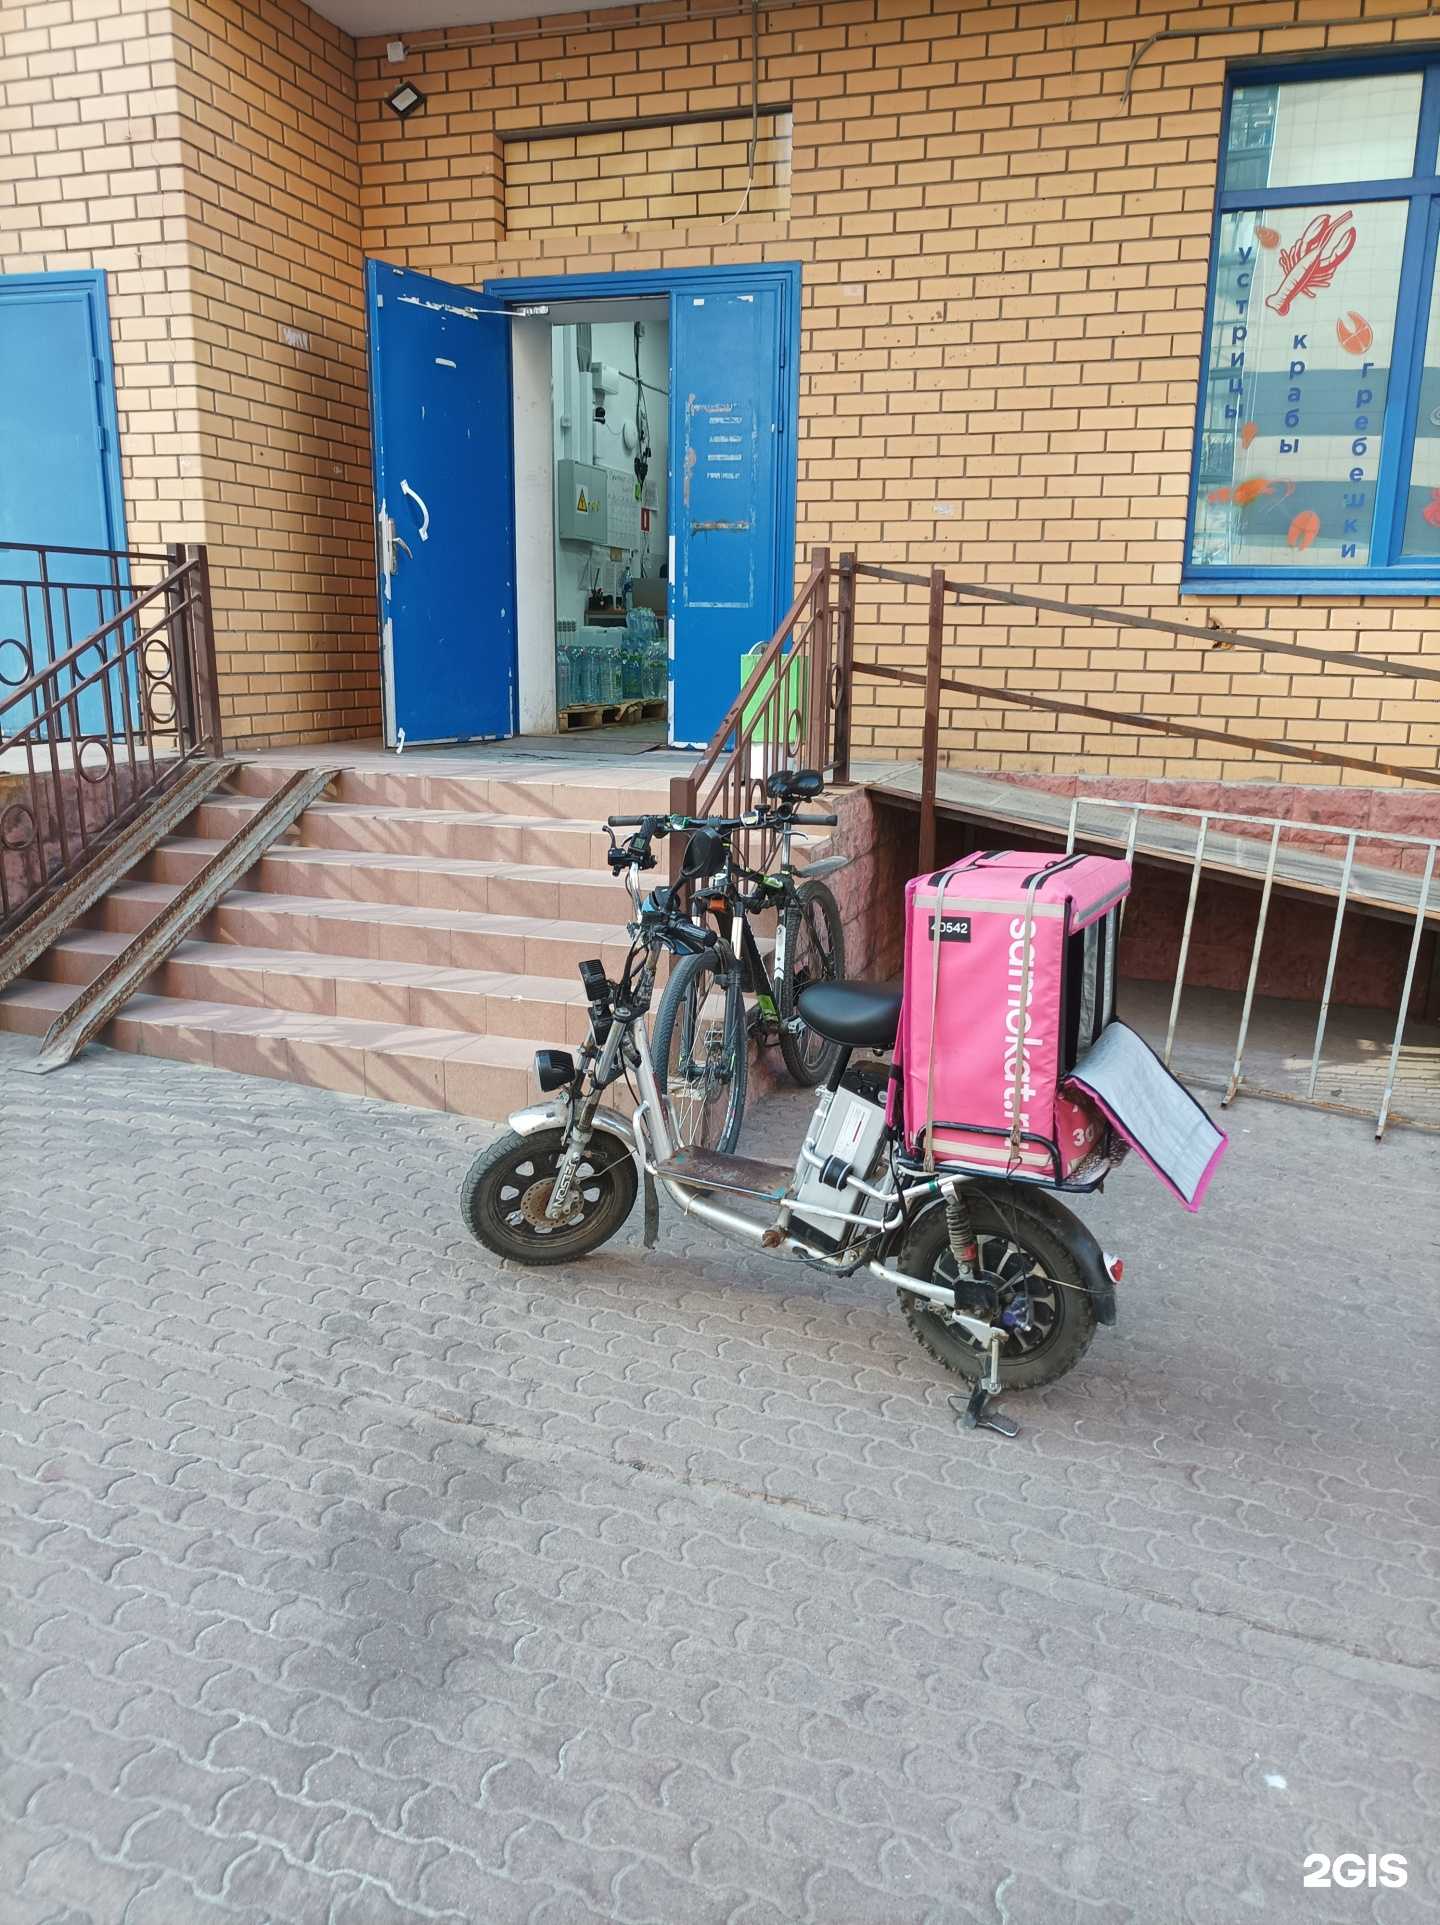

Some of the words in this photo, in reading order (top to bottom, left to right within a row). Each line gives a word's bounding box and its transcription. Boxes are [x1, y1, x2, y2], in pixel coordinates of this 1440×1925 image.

[1225, 246, 1252, 419] устрицы
[1280, 334, 1307, 454] крабы
[1341, 362, 1374, 558] гребешки
